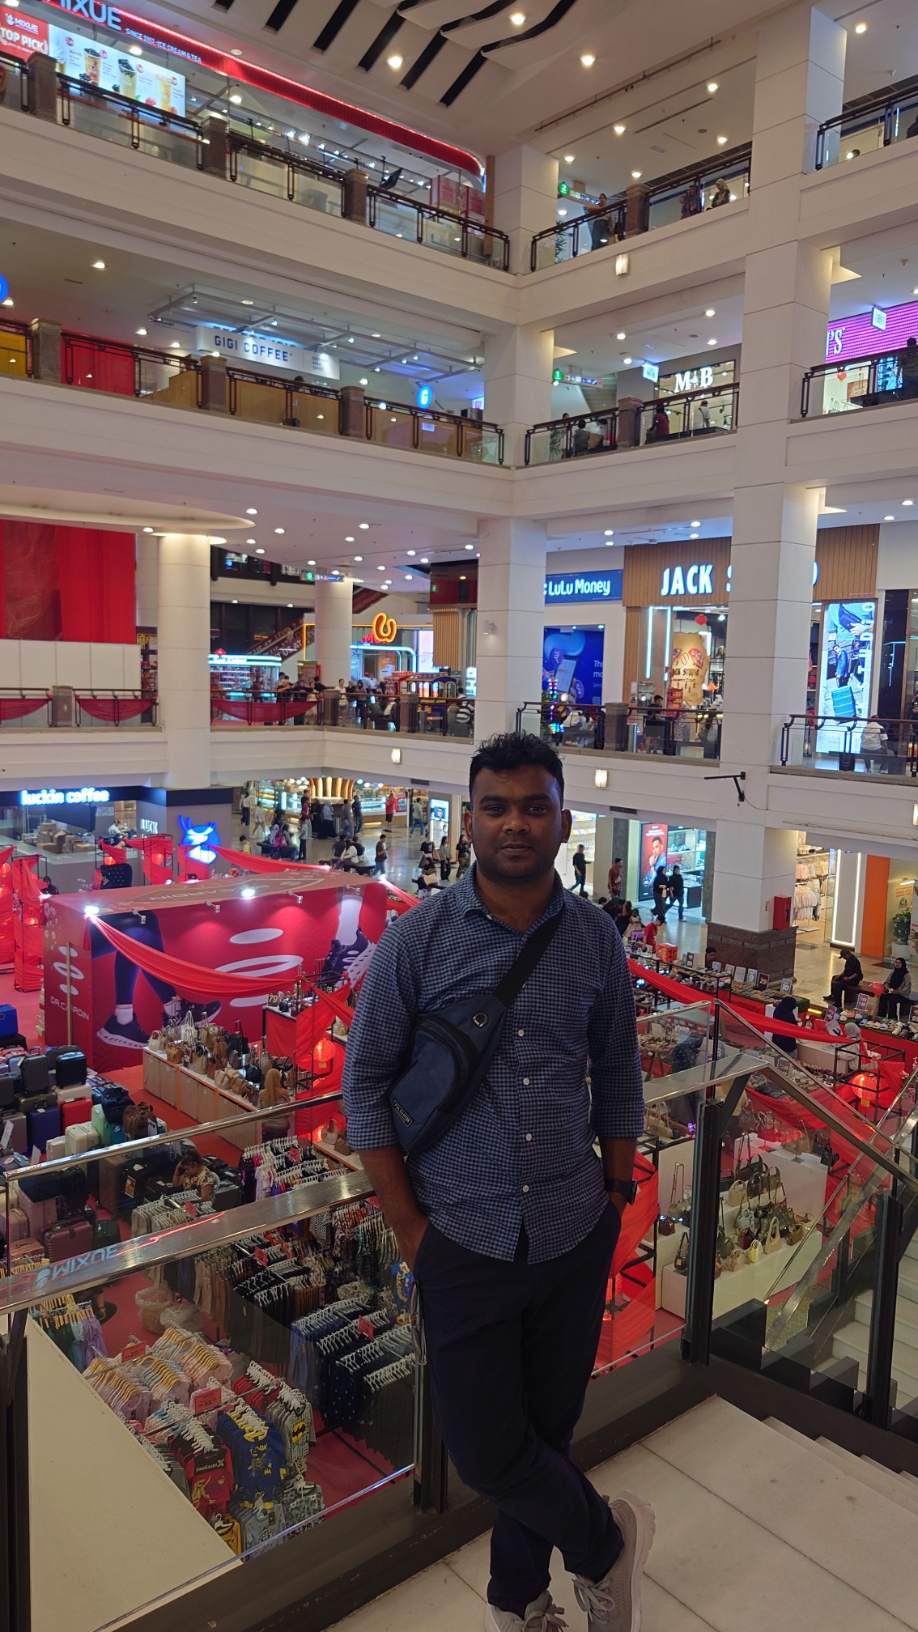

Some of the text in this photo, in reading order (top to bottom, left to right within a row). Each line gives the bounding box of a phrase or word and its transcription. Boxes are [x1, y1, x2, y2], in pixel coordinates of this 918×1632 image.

[214, 335, 289, 362] GIGI COFFEE
[548, 579, 611, 596] LuLu Money
[660, 564, 713, 596] JACK
[21, 787, 109, 805] luckin coffee
